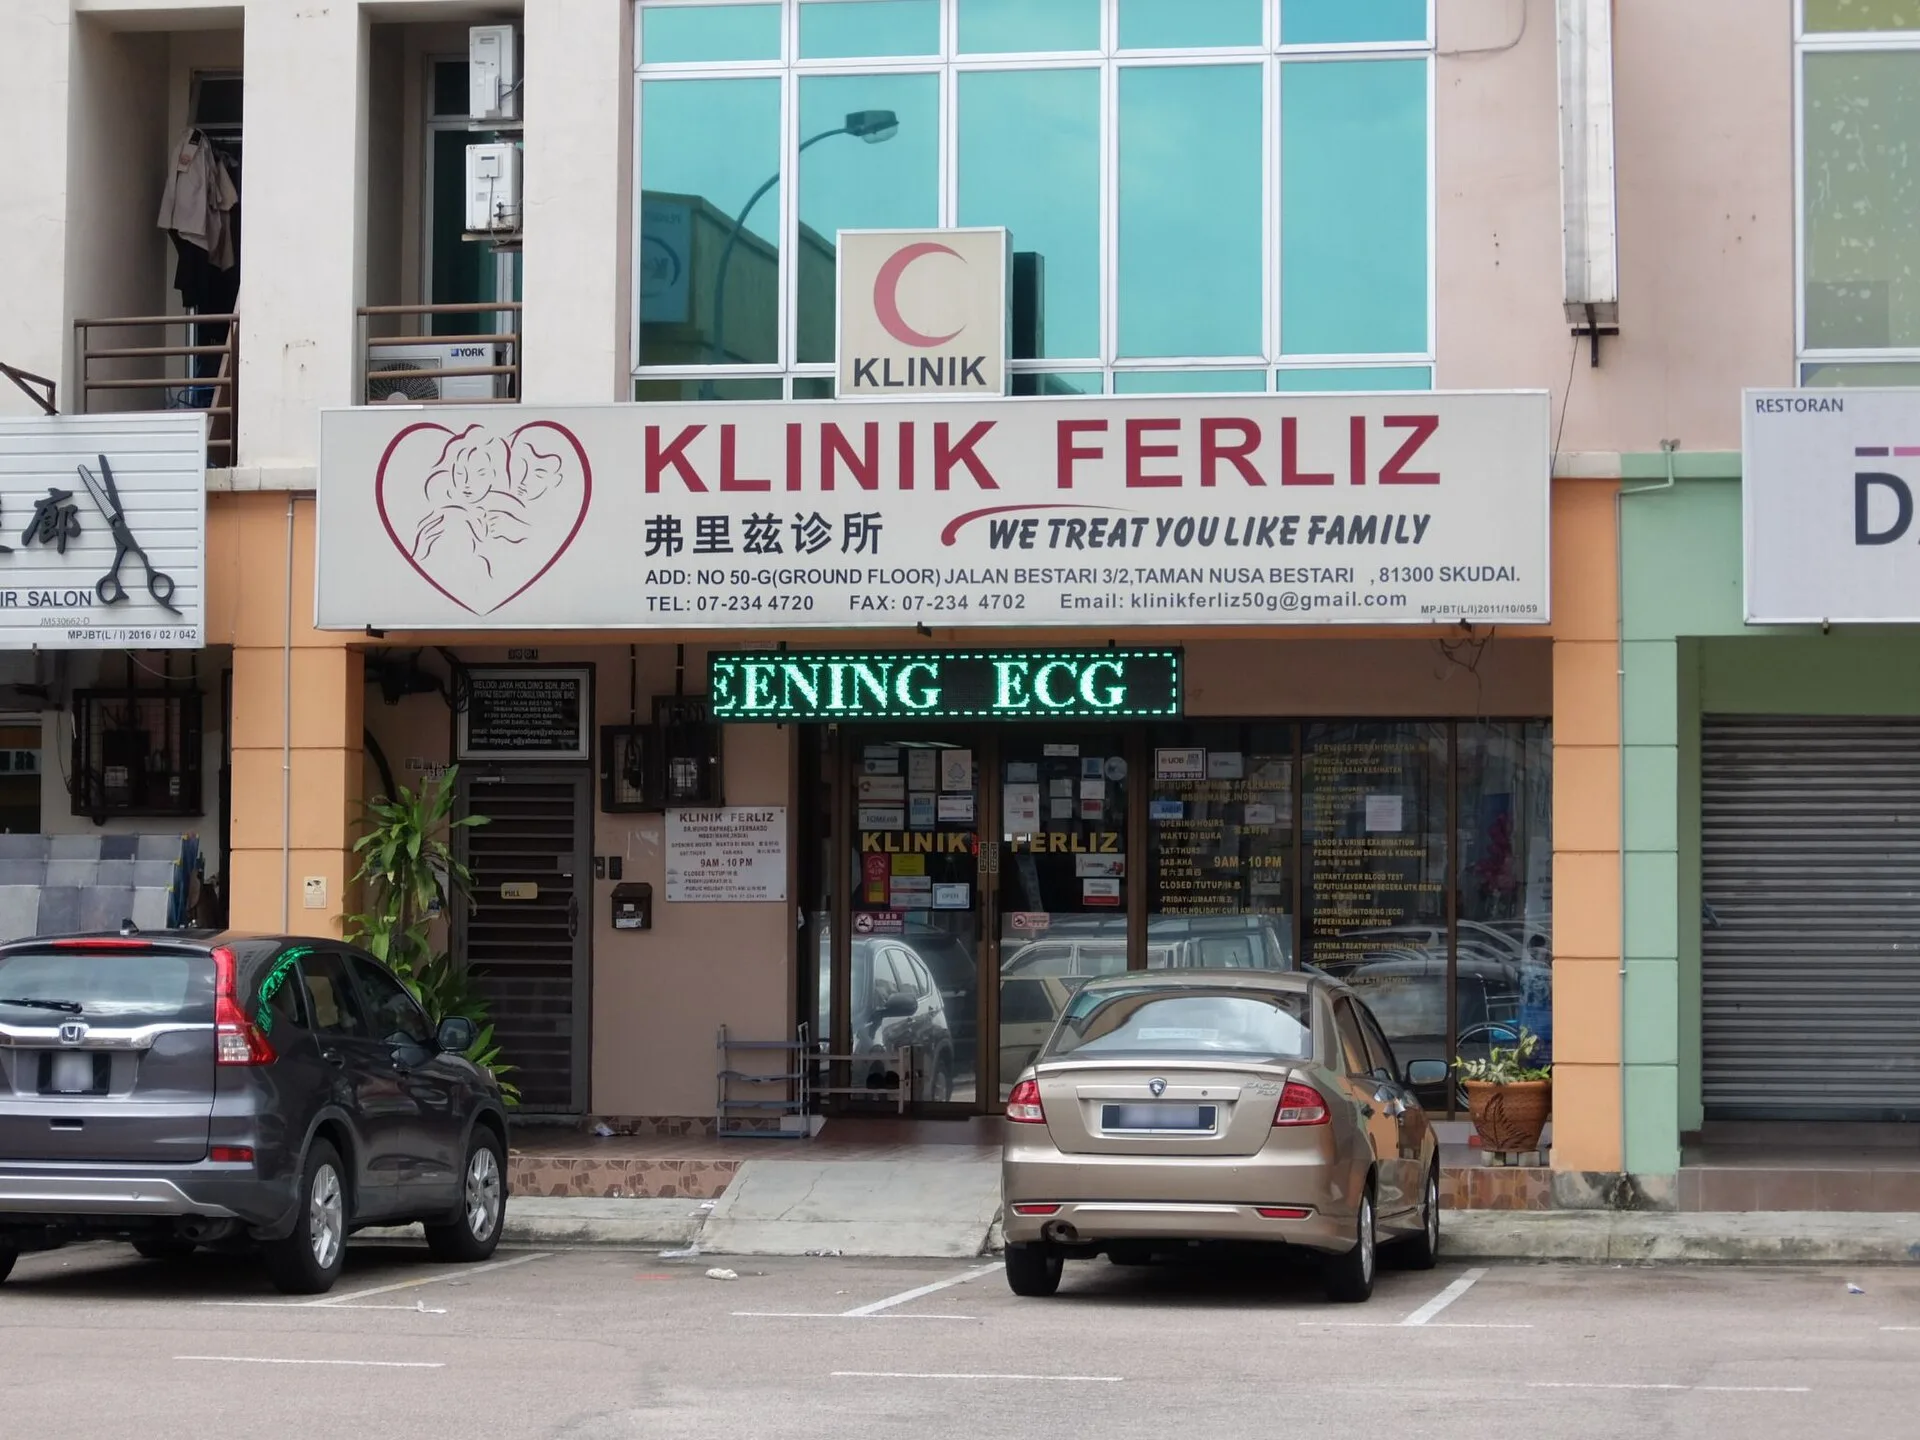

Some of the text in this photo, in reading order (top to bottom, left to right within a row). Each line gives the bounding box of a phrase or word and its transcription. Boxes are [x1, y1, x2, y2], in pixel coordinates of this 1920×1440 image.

[460, 348, 484, 357] YORK
[854, 356, 987, 387] KLINIK
[1756, 398, 1844, 413] RESTORAN
[645, 415, 1440, 493] KLINIK FERLIZ
[1855, 471, 1920, 546] D
[644, 511, 883, 557] 弗里兹诊所
[988, 513, 1431, 550] WE TREAT YOU LIKE FAMILY
[645, 569, 692, 586] ADD:
[697, 569, 725, 585] NO
[868, 568, 941, 588] FLOOR)
[945, 568, 1009, 585] JALAN
[1014, 568, 1098, 584] BESTARI
[1209, 567, 1265, 584] NUSA
[1269, 567, 1354, 583] BESTARI
[1439, 566, 1521, 582] SKUDAI.
[28, 590, 91, 607] SALON
[646, 591, 1407, 611] TEL: 07-234 4720 FAX: 07-234 4702 Email: klinikferliz50g@gmail.com
[129, 630, 151, 640] 2016
[992, 661, 1127, 708] ECG
[679, 812, 775, 822] KLINIK FERLIZ
[1160, 819, 1225, 828] OPENING HOURS
[862, 832, 1119, 853] KLINIK FERLIZ
[1160, 832, 1189, 840] WAKTU
[1200, 832, 1222, 840] BUKA
[700, 858, 720, 867] 9AM
[727, 858, 737, 867] 10
[739, 858, 753, 867] PM
[1213, 855, 1239, 868] 9AM
[1249, 855, 1262, 868] 10
[1264, 855, 1282, 868] PM
[1160, 881, 1192, 889] CLOSED
